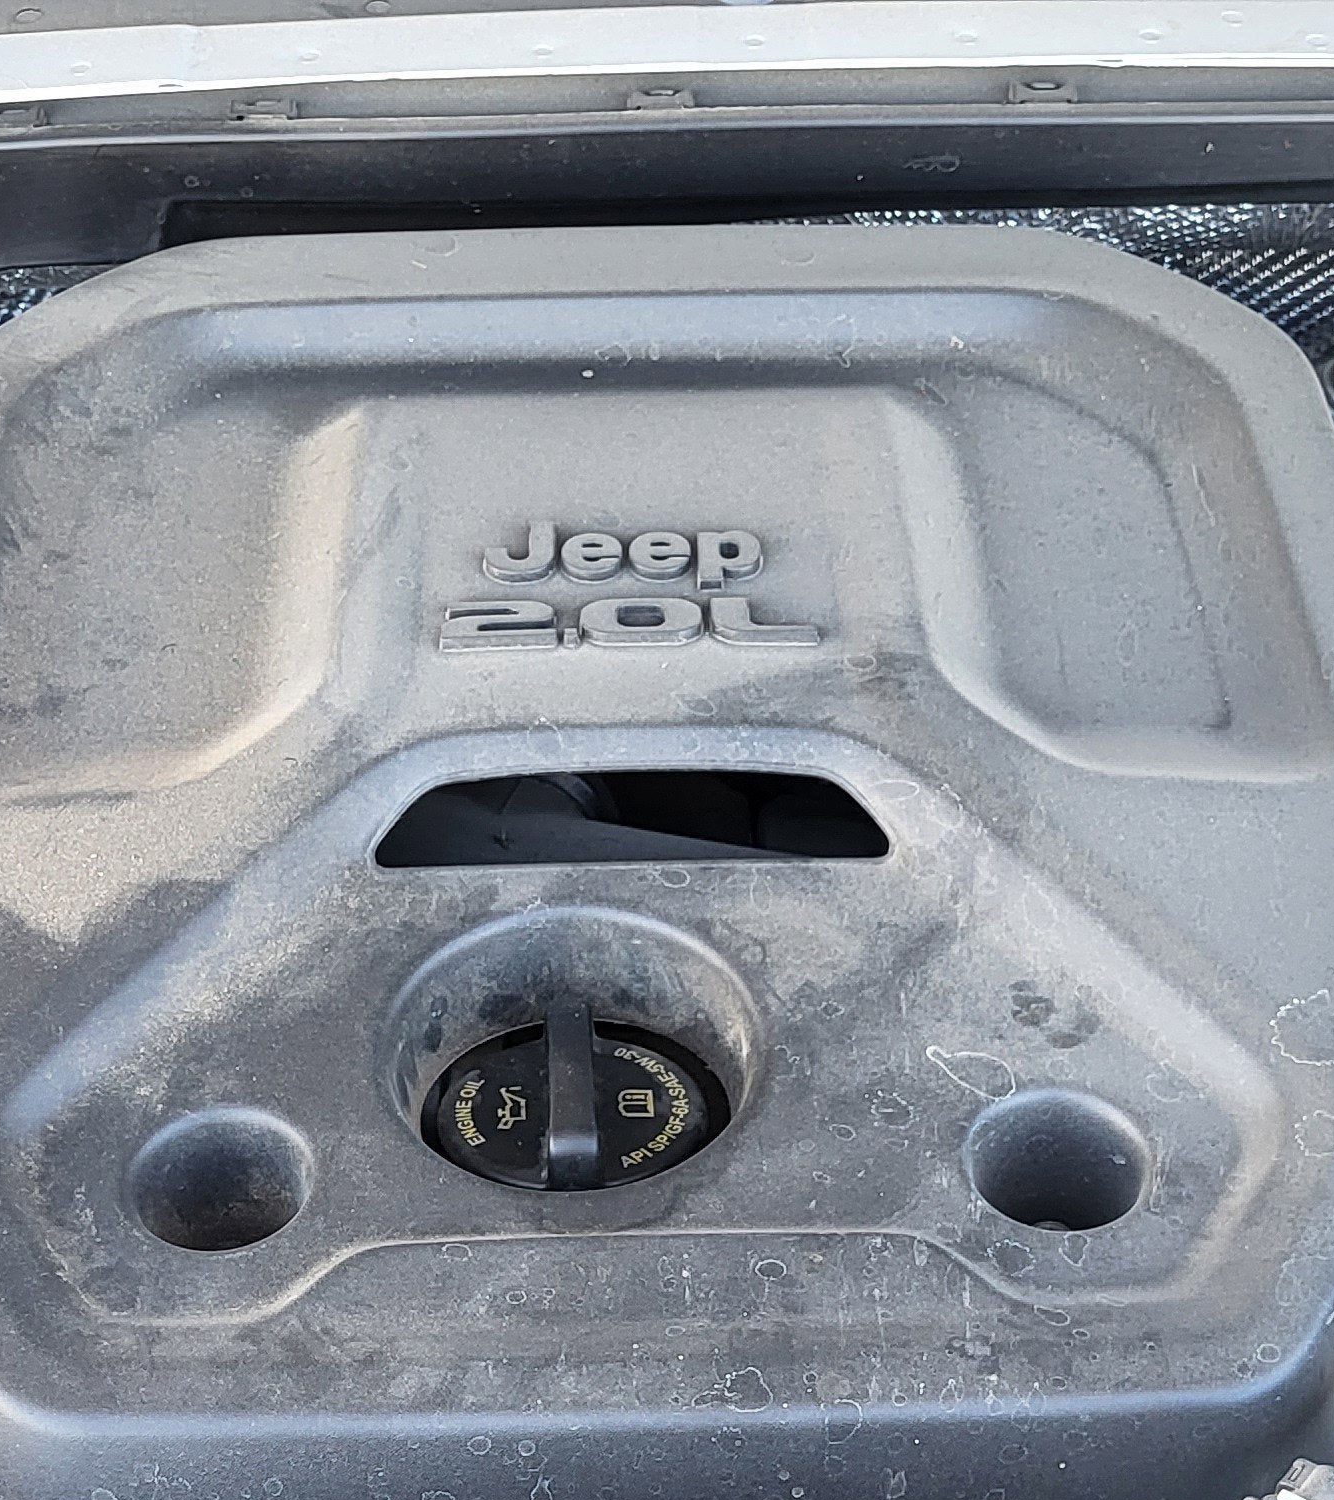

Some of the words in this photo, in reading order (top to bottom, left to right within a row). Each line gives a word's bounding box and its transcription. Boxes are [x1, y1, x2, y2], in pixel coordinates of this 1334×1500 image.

[482, 520, 764, 591] Jeep
[439, 597, 820, 653] 2.0L
[460, 1076, 486, 1099] OIL
[453, 1098, 487, 1148] ENGINE
[621, 1147, 654, 1169] API
